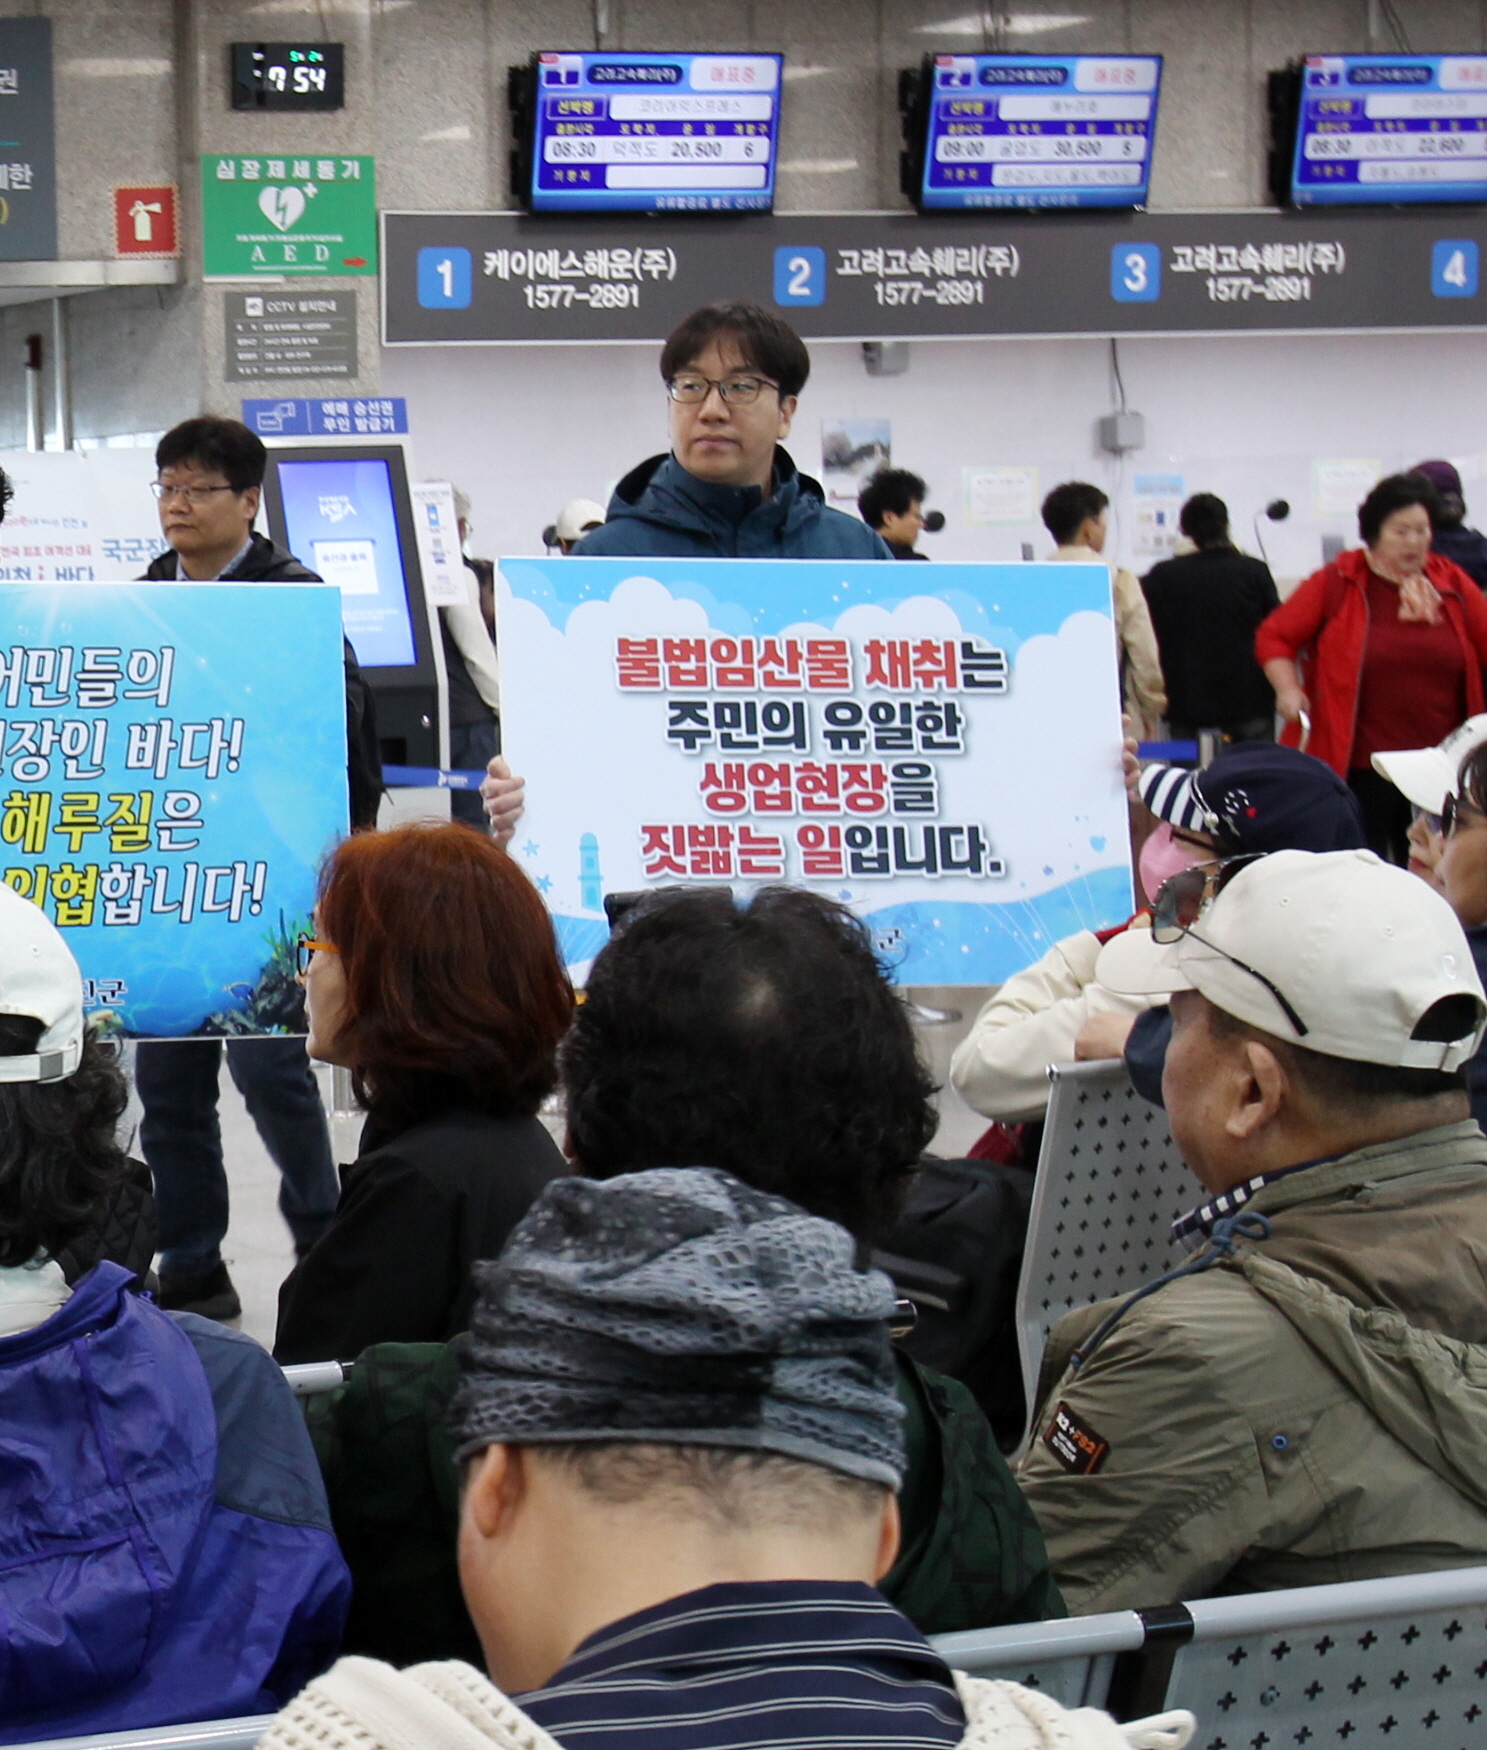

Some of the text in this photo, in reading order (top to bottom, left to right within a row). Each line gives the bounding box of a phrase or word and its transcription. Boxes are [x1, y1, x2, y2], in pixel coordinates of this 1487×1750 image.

[216, 159, 361, 180] 심장제세동기
[552, 140, 597, 159] 08:30
[670, 140, 723, 160] 20,500
[744, 141, 755, 159] 6
[436, 247, 678, 298] 1 케이에스해운(주)
[787, 244, 1020, 297] 2 고려고속훼리(주)
[874, 280, 985, 306] 1577-2891
[1123, 242, 1346, 293] 3 고려고속훼리(주)
[1206, 276, 1312, 301] 1577-2891
[1442, 248, 1467, 288] 4
[266, 300, 296, 313] CCTV
[524, 284, 640, 309] 1577-2891
[615, 635, 1008, 692] 불법임산물 채취는
[127, 719, 244, 778] 바다!
[667, 700, 963, 752] 주민의 유일한
[700, 761, 938, 815] 생업현장을
[0, 790, 204, 854] 해루질은
[640, 825, 1004, 876] 짓밟는 일입니다.
